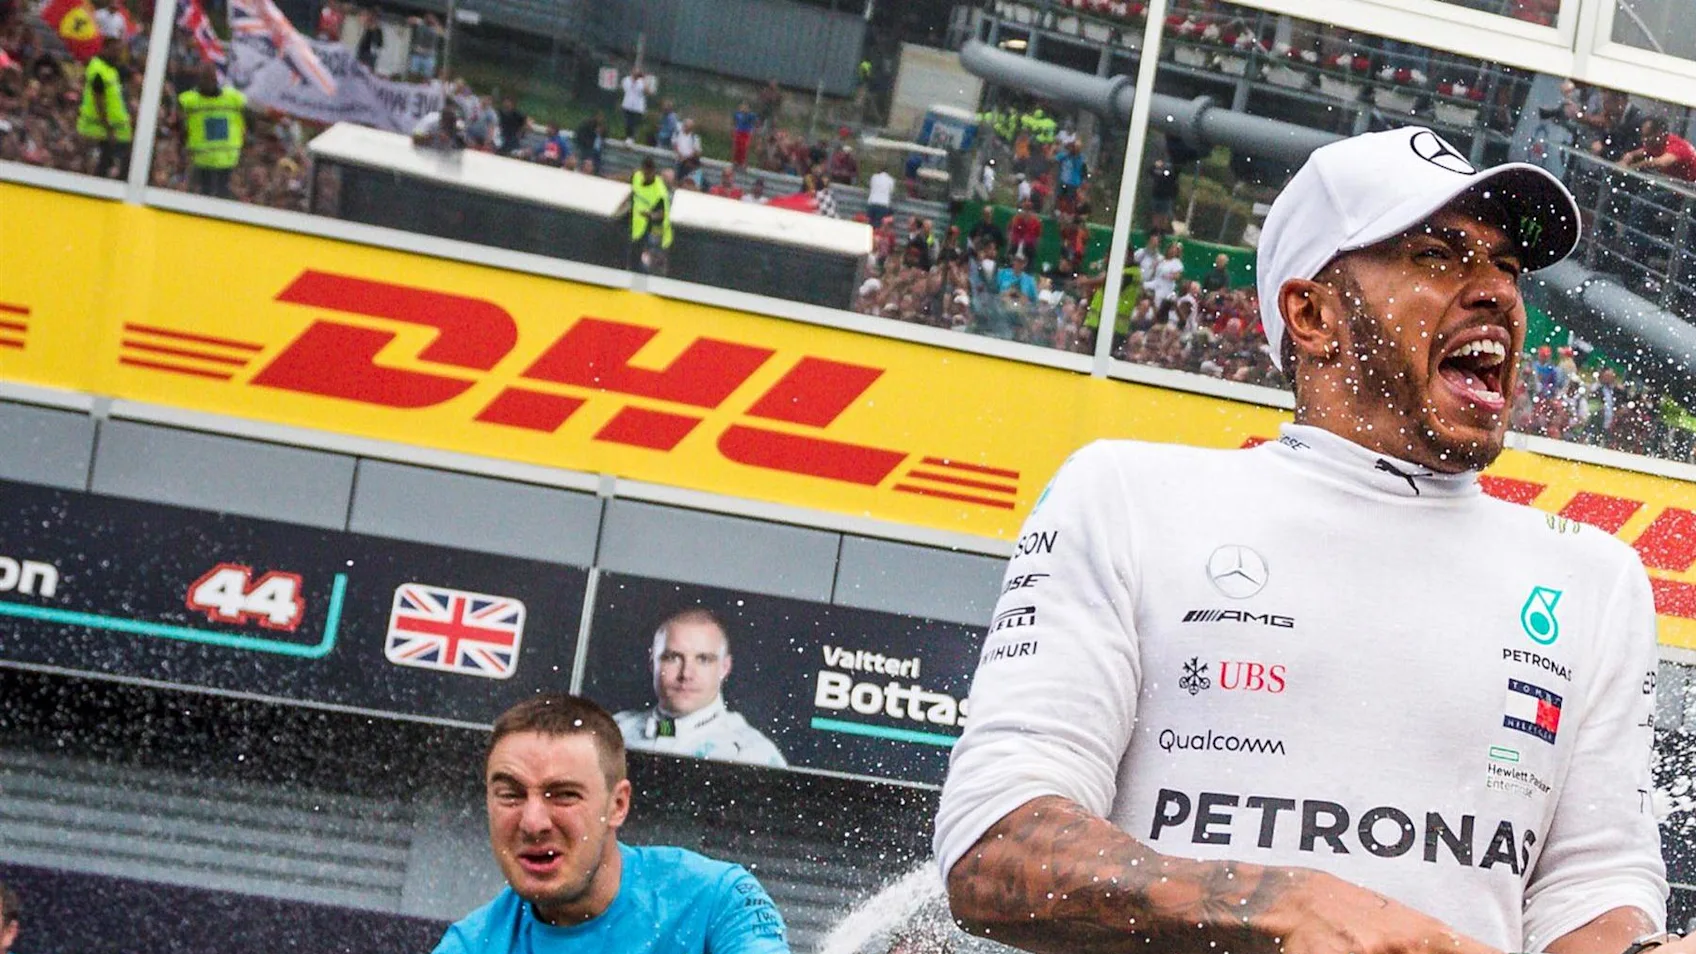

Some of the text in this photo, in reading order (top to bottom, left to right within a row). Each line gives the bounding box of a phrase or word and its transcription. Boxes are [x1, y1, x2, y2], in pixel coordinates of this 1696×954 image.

[251, 269, 909, 487] DHL
[187, 562, 304, 632] 44
[1216, 610, 1295, 629] AMG
[822, 644, 922, 680] Valtteri
[1219, 660, 1287, 694] UBS
[1502, 648, 1572, 682] PETRONAS
[1158, 728, 1287, 756] Qualcomm
[1149, 787, 1537, 877] PETRONAS
